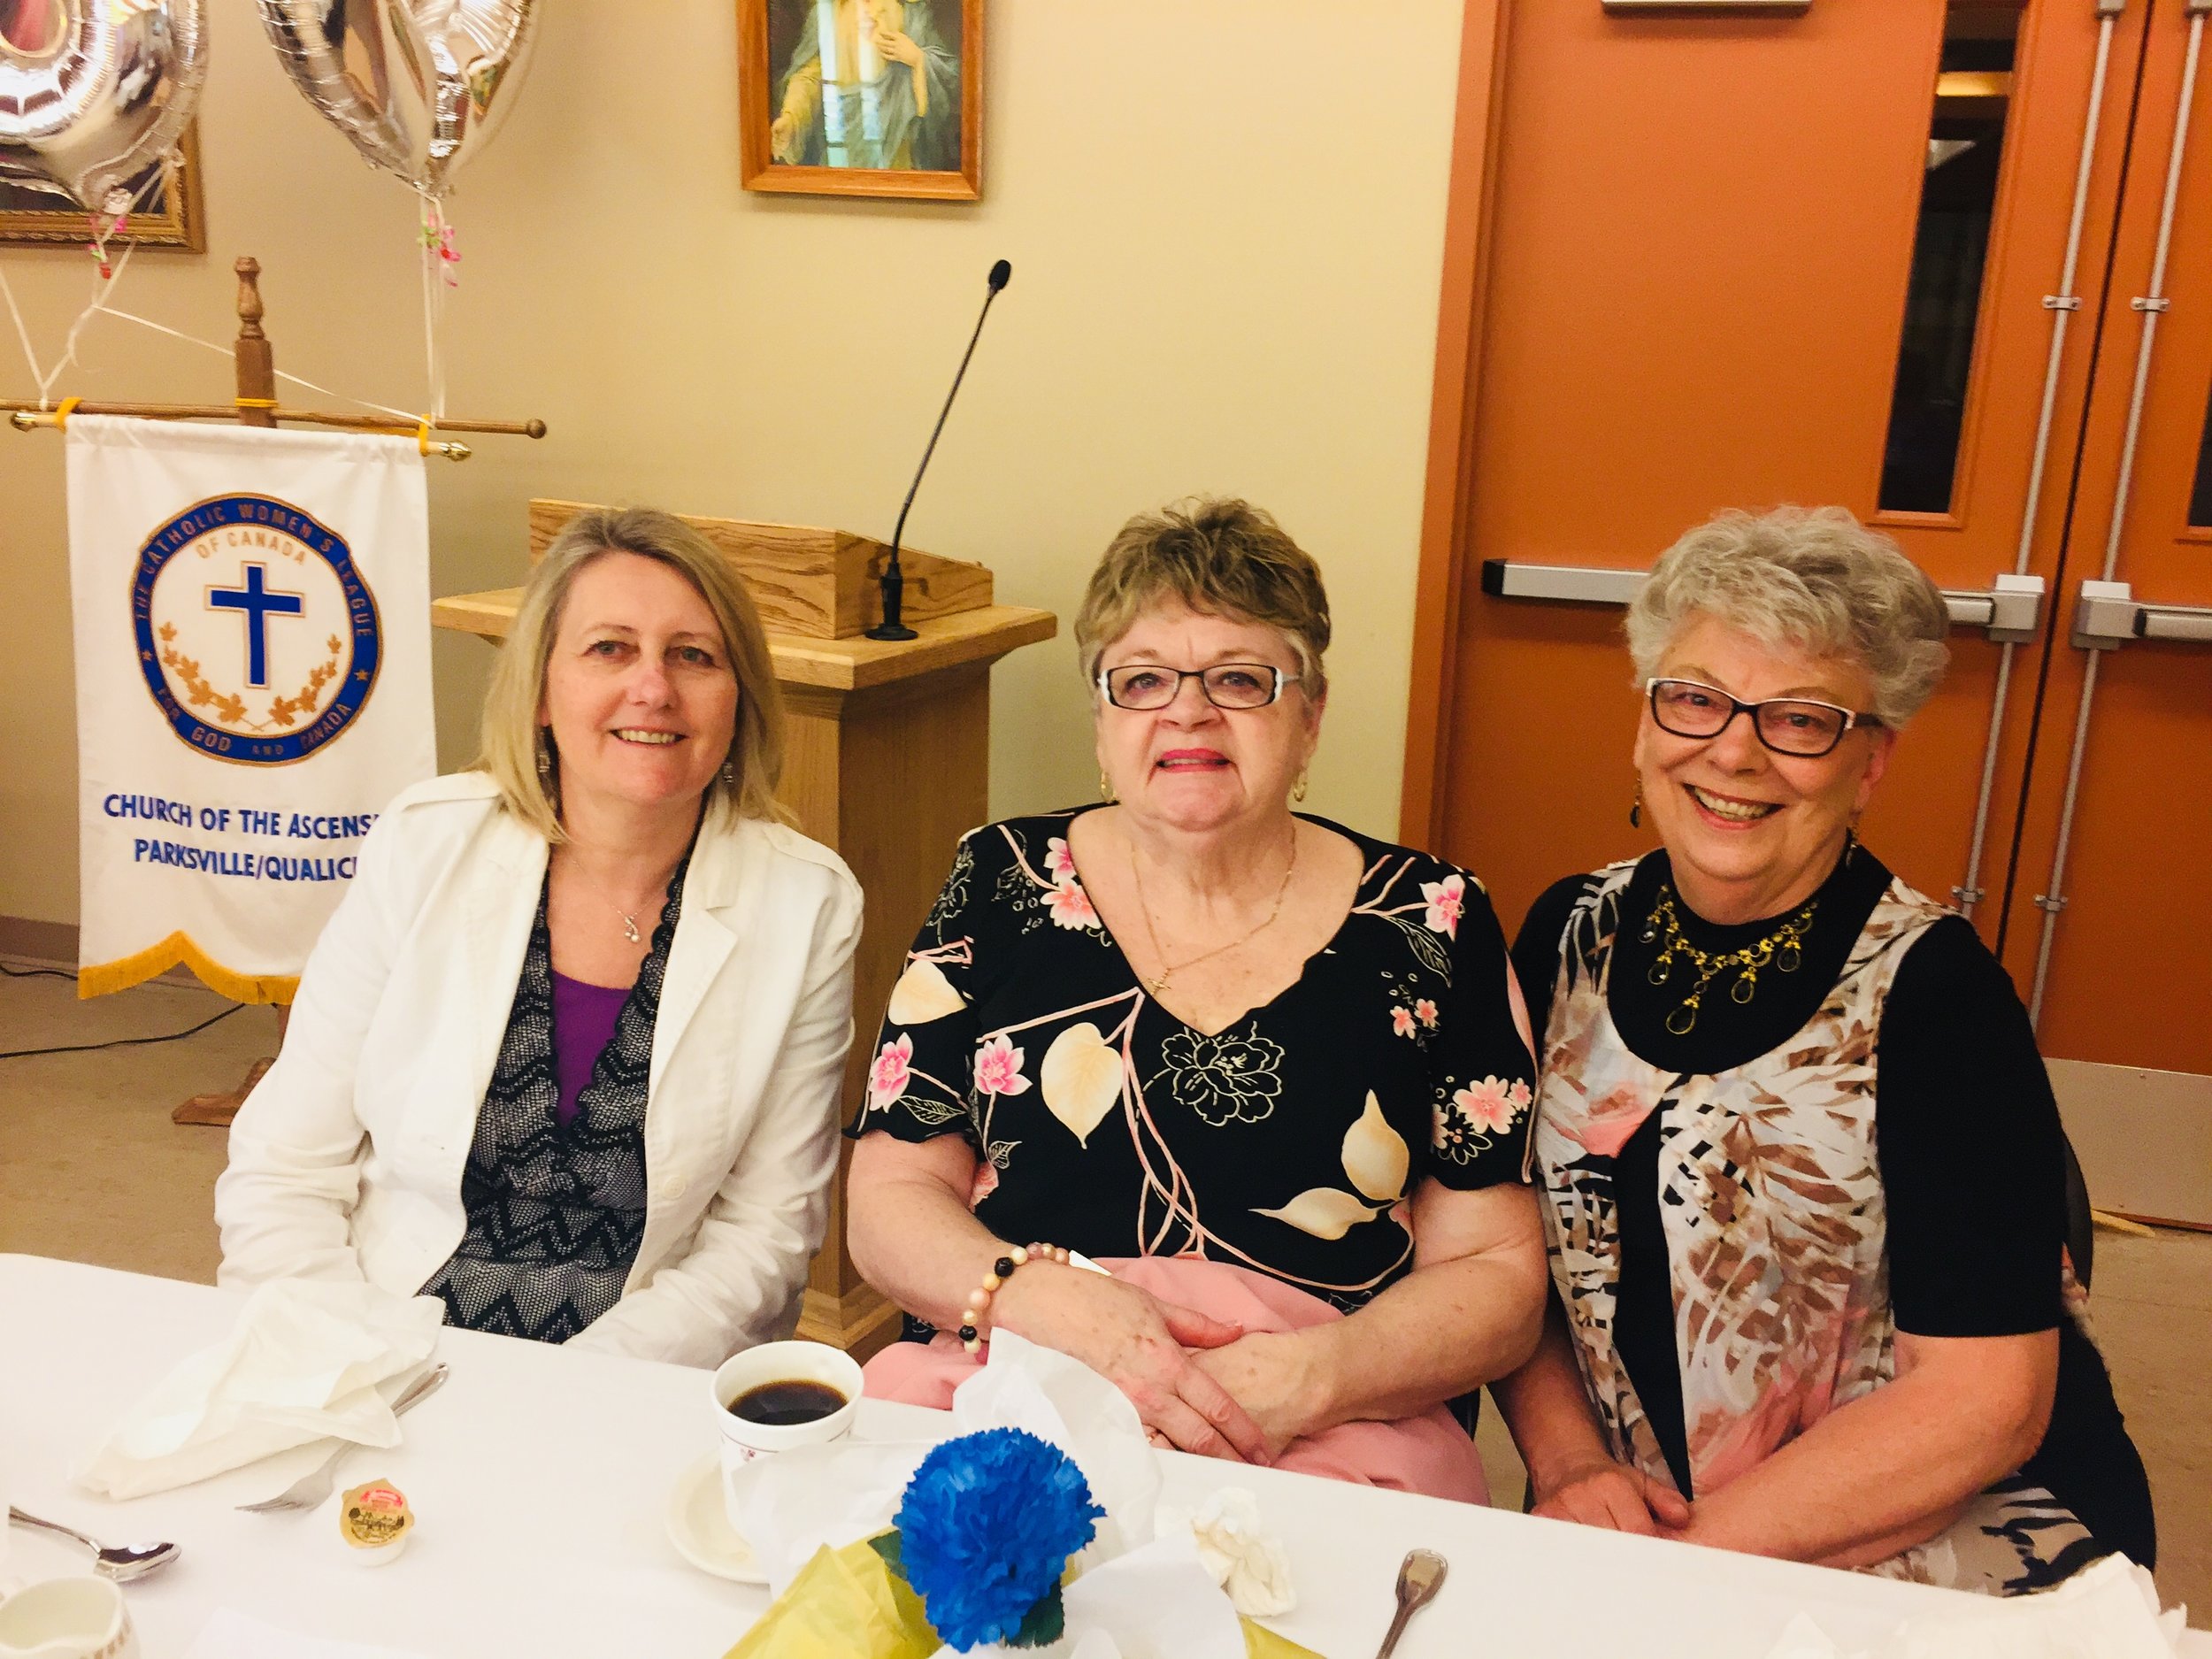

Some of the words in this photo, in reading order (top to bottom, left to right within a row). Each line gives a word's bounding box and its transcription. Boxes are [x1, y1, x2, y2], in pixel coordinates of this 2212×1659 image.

[196, 536, 219, 558] OF
[227, 531, 306, 565] CANADA
[141, 506, 226, 574] CATHOLIC
[336, 558, 373, 636] LEAGUE
[191, 726, 233, 751] GOD
[104, 793, 193, 828] CHURCH
[200, 807, 231, 832] OF
[238, 809, 280, 836] THE
